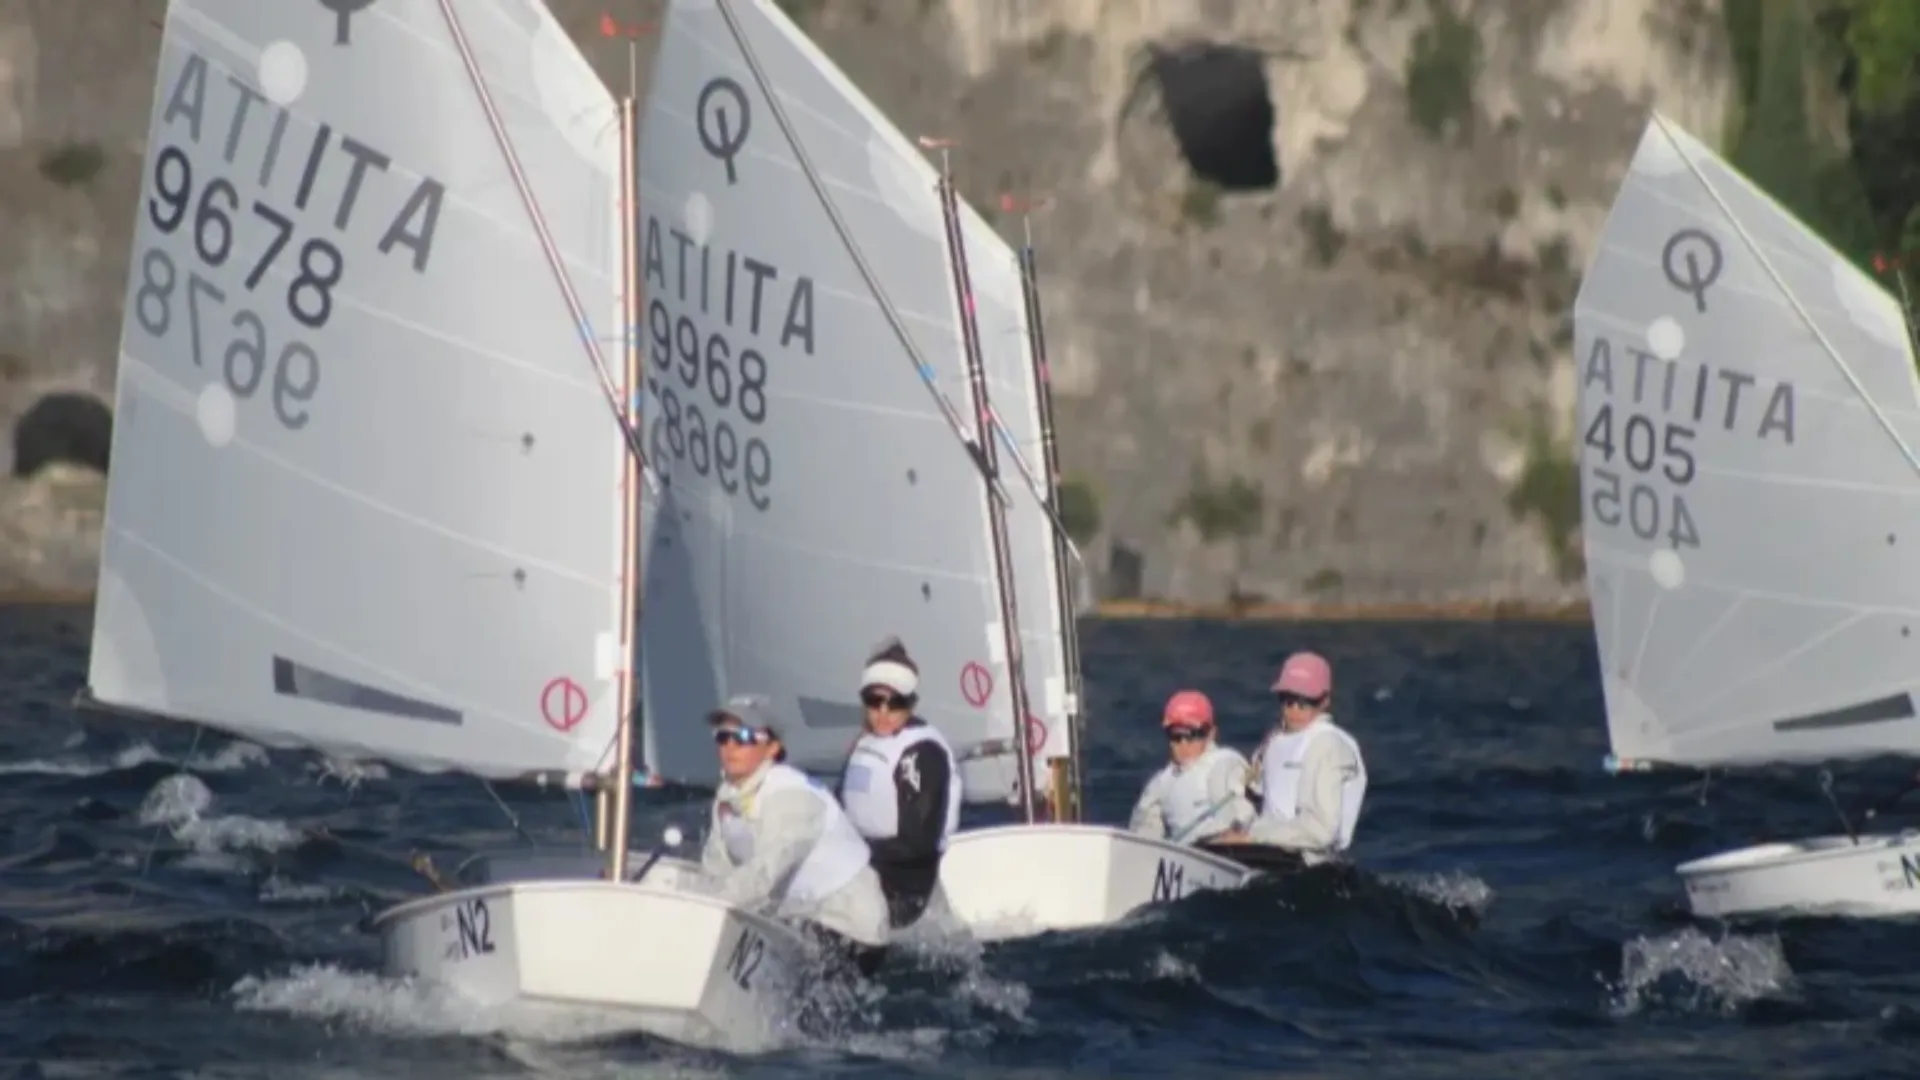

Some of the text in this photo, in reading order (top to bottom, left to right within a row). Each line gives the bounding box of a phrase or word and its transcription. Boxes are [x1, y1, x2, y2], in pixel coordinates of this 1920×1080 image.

[149, 145, 344, 329] 9678
[294, 123, 446, 273] ITA
[725, 249, 815, 355] ITA
[649, 297, 768, 426] 9968
[1584, 403, 1697, 486] 405
[1692, 363, 1795, 444] ITA
[1151, 857, 1184, 903] N1
[457, 897, 496, 960] N2
[726, 928, 764, 991] N2
